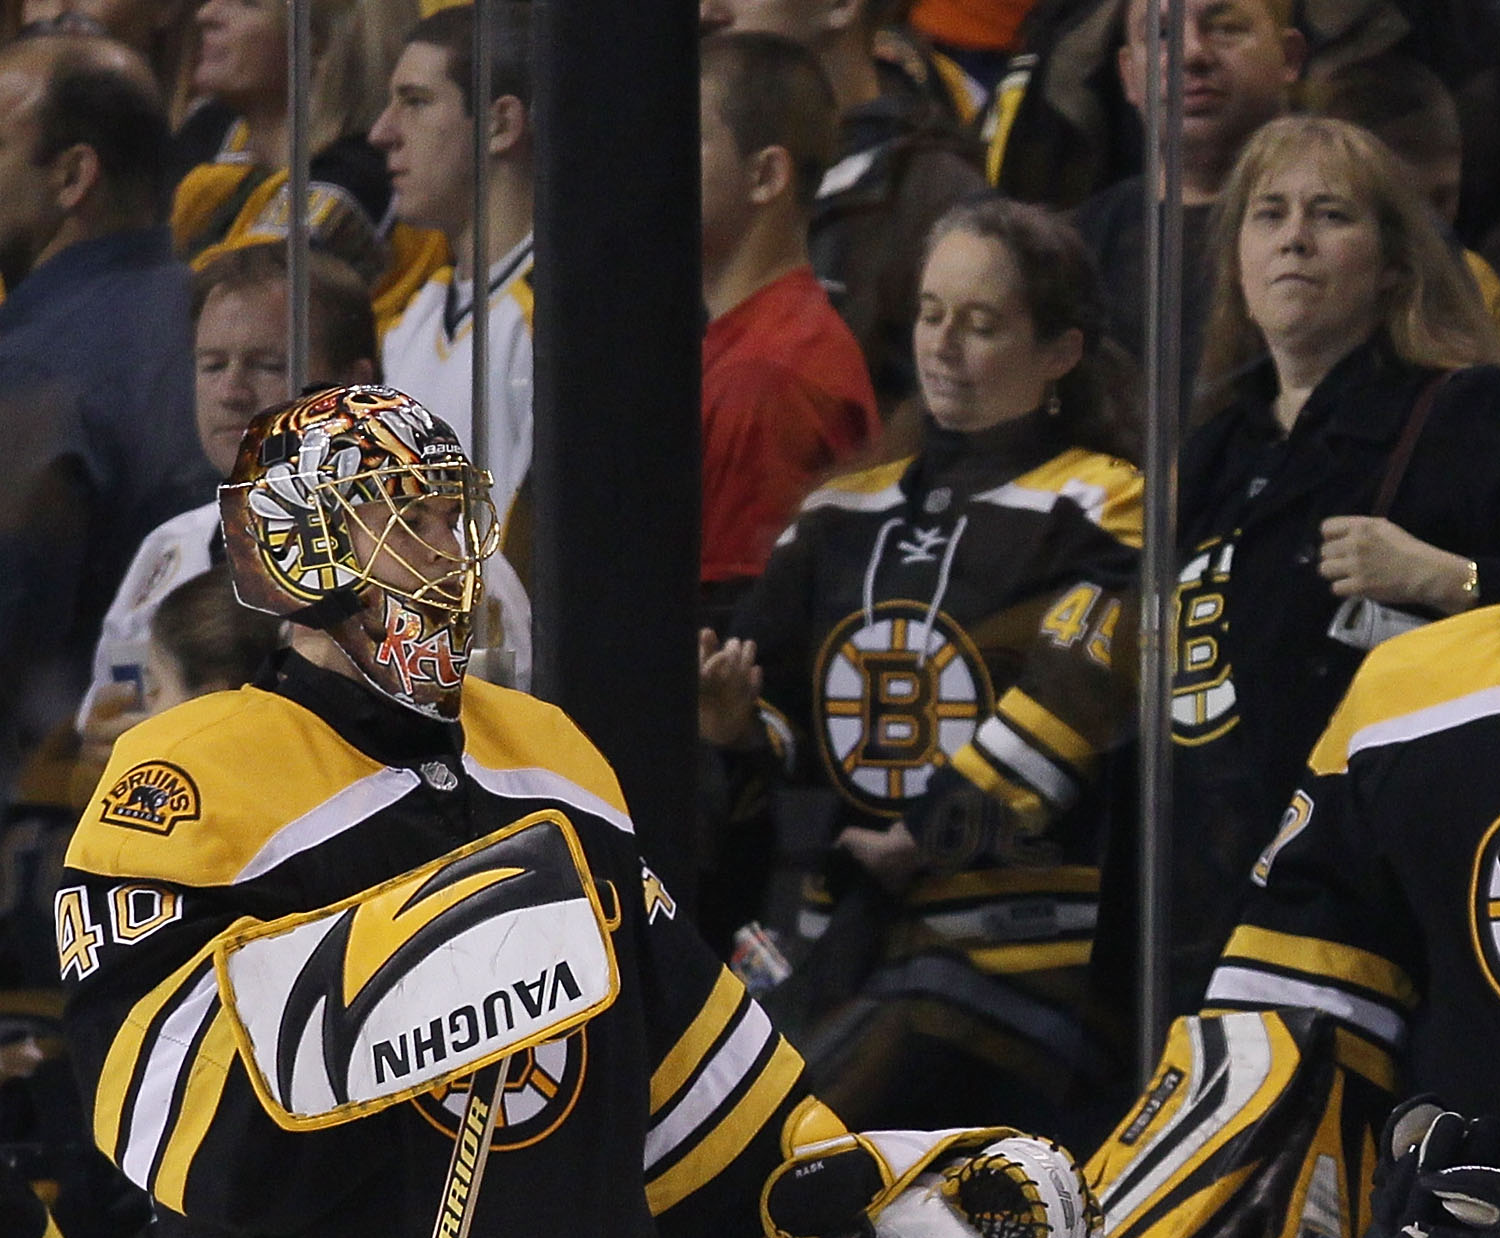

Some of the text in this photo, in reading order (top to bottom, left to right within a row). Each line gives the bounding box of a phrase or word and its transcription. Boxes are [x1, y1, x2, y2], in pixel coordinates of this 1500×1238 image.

[375, 595, 474, 696] RA
[109, 769, 190, 812] BRUINS
[54, 884, 184, 982] 40
[371, 960, 583, 1085] VAUGHN
[795, 1160, 825, 1178] RASK
